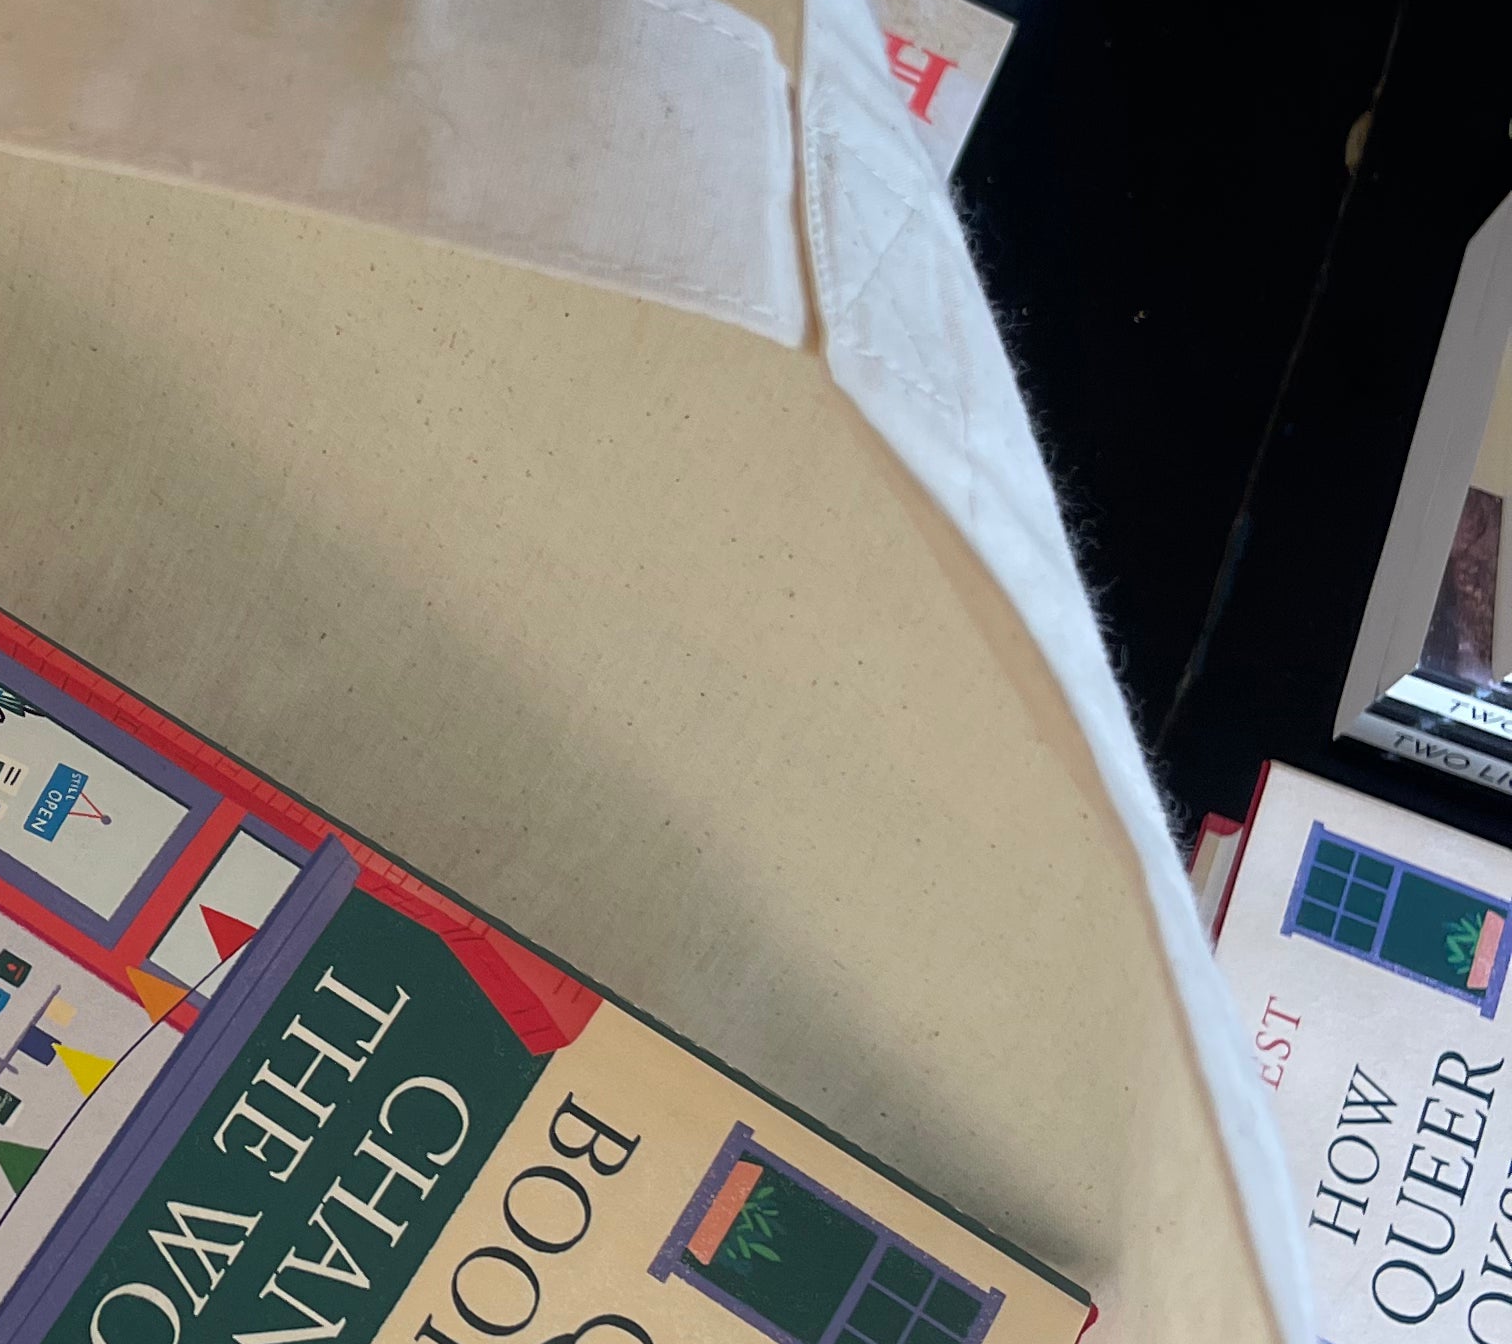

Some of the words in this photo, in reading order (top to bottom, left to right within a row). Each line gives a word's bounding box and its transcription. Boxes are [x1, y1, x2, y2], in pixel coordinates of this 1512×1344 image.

[66, 773, 82, 800] STILL
[1394, 731, 1470, 771] TWO
[31, 789, 63, 833] OPEN
[212, 964, 410, 1184] THE
[1308, 1063, 1398, 1246] HOW
[1372, 1051, 1505, 1325] QUEER
